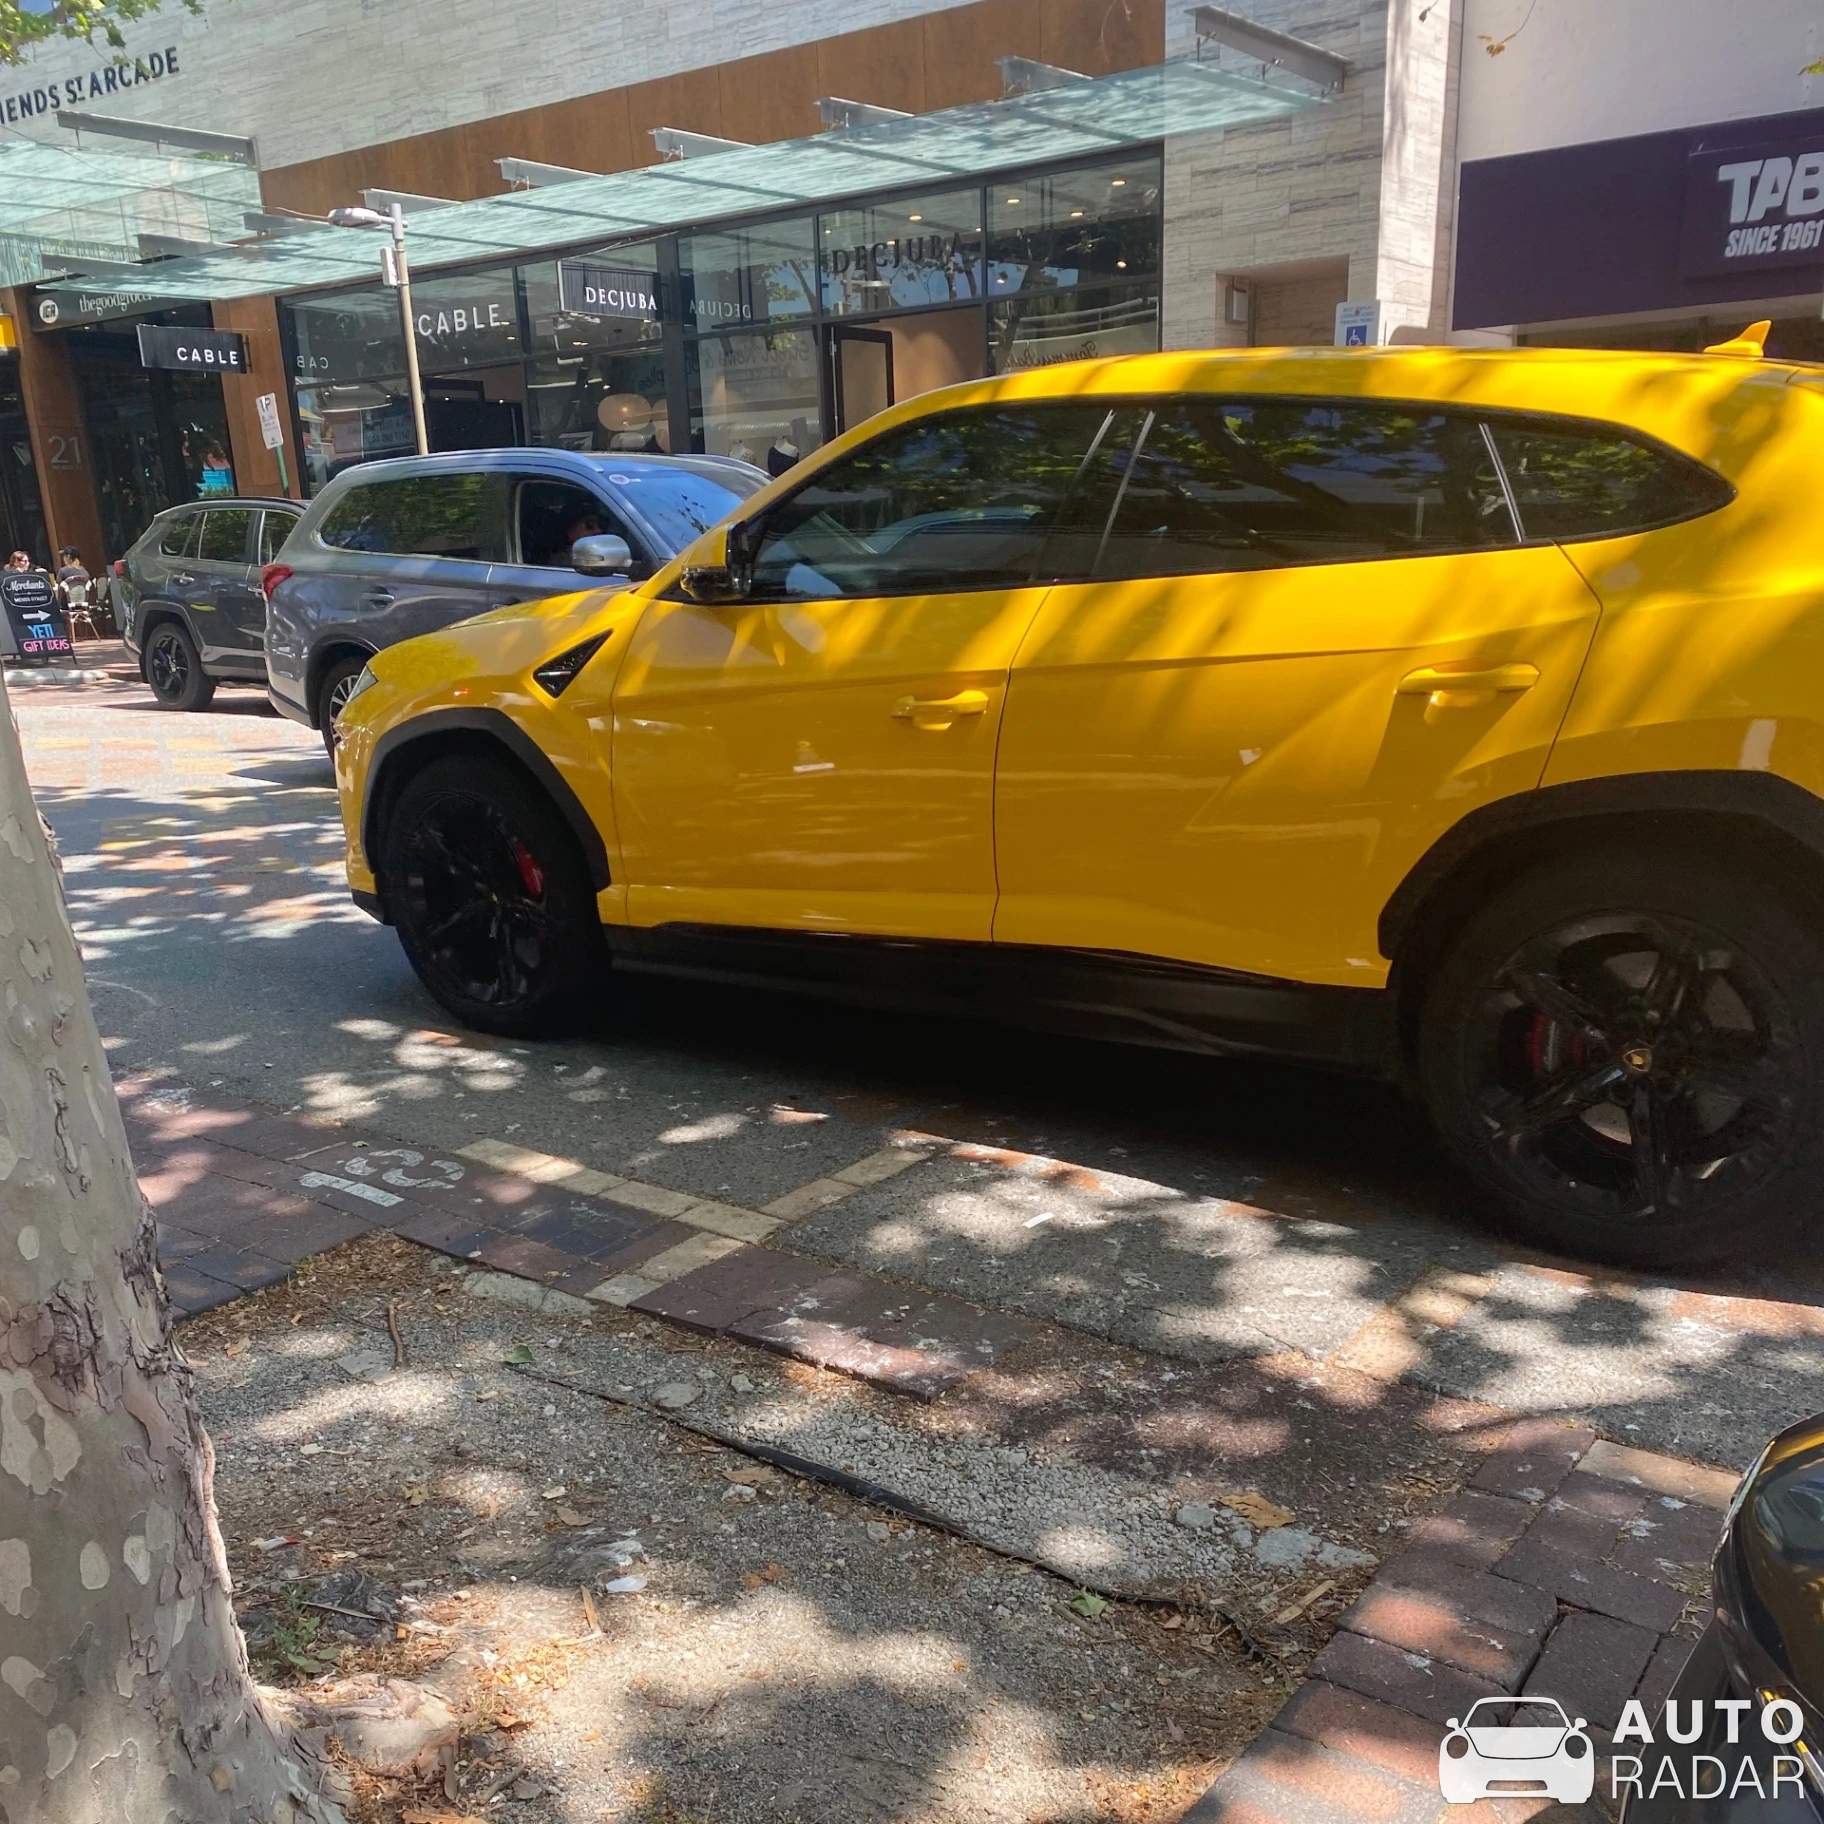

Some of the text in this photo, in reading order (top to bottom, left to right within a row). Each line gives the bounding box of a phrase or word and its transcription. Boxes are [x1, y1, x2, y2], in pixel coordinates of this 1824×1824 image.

[89, 46, 180, 98] ARCADE
[1718, 151, 1824, 224] TAB
[1724, 219, 1824, 258] SINCE 1961
[831, 231, 964, 274] DECJUBA
[42, 304, 56, 318] IGA
[585, 286, 658, 311] DECJUBA
[418, 304, 501, 336] CABLE
[176, 347, 239, 365] CABLE
[48, 435, 81, 464] 21
[6, 580, 45, 592] Merchants
[27, 623, 55, 638] YETI
[24, 639, 70, 652] GIFT IDEAS
